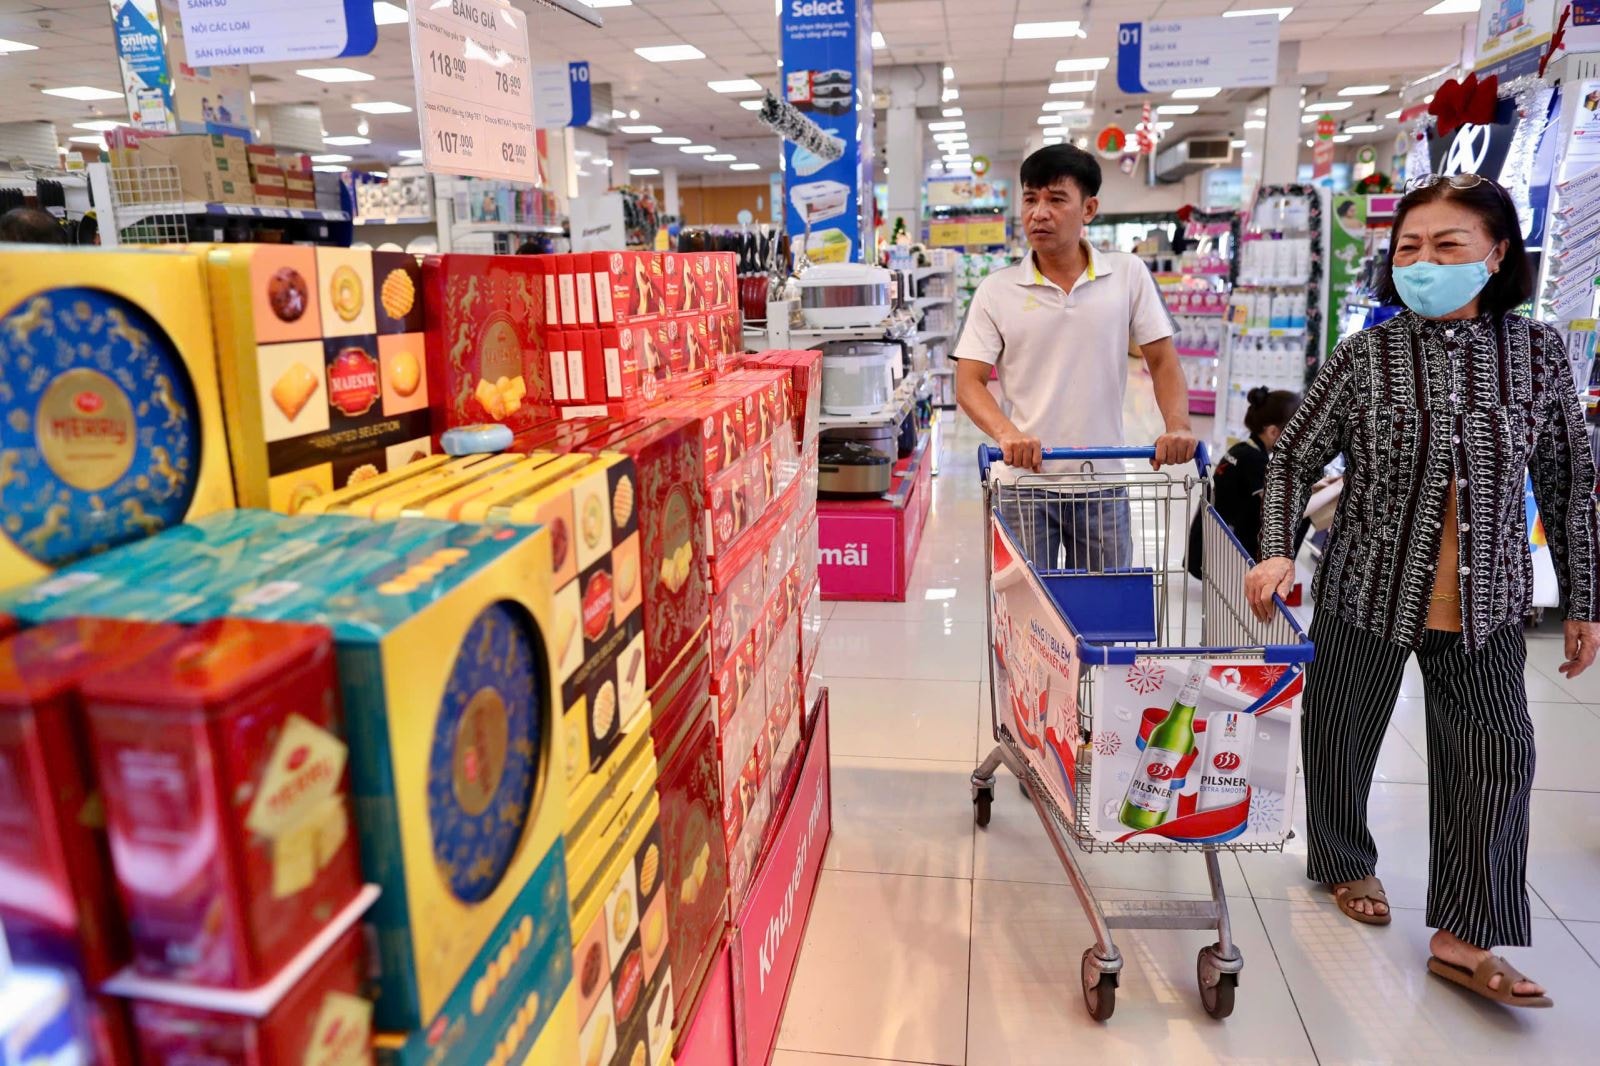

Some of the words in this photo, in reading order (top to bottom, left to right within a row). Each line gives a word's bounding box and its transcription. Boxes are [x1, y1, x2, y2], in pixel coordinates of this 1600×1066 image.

[791, 0, 844, 17] Select
[480, 9, 497, 31] GIÁ
[121, 34, 158, 46] online
[1120, 28, 1139, 46] 01
[242, 46, 265, 55] INOX
[571, 66, 588, 82] 10
[1564, 172, 1599, 192] SENSODYNE
[1565, 219, 1599, 240] SENSODYNE
[1560, 265, 1592, 287] SENSODYNE
[1555, 287, 1587, 310] SENSODYNE
[358, 420, 401, 439] SELECTION
[817, 543, 868, 566] mãi
[1132, 779, 1172, 799] PILSNER
[1200, 775, 1247, 788] PILSNER
[1200, 785, 1219, 793] EXTRA
[1220, 786, 1247, 794] SMOOTH
[758, 831, 808, 994] Khuyến
[808, 766, 824, 848] mãi
